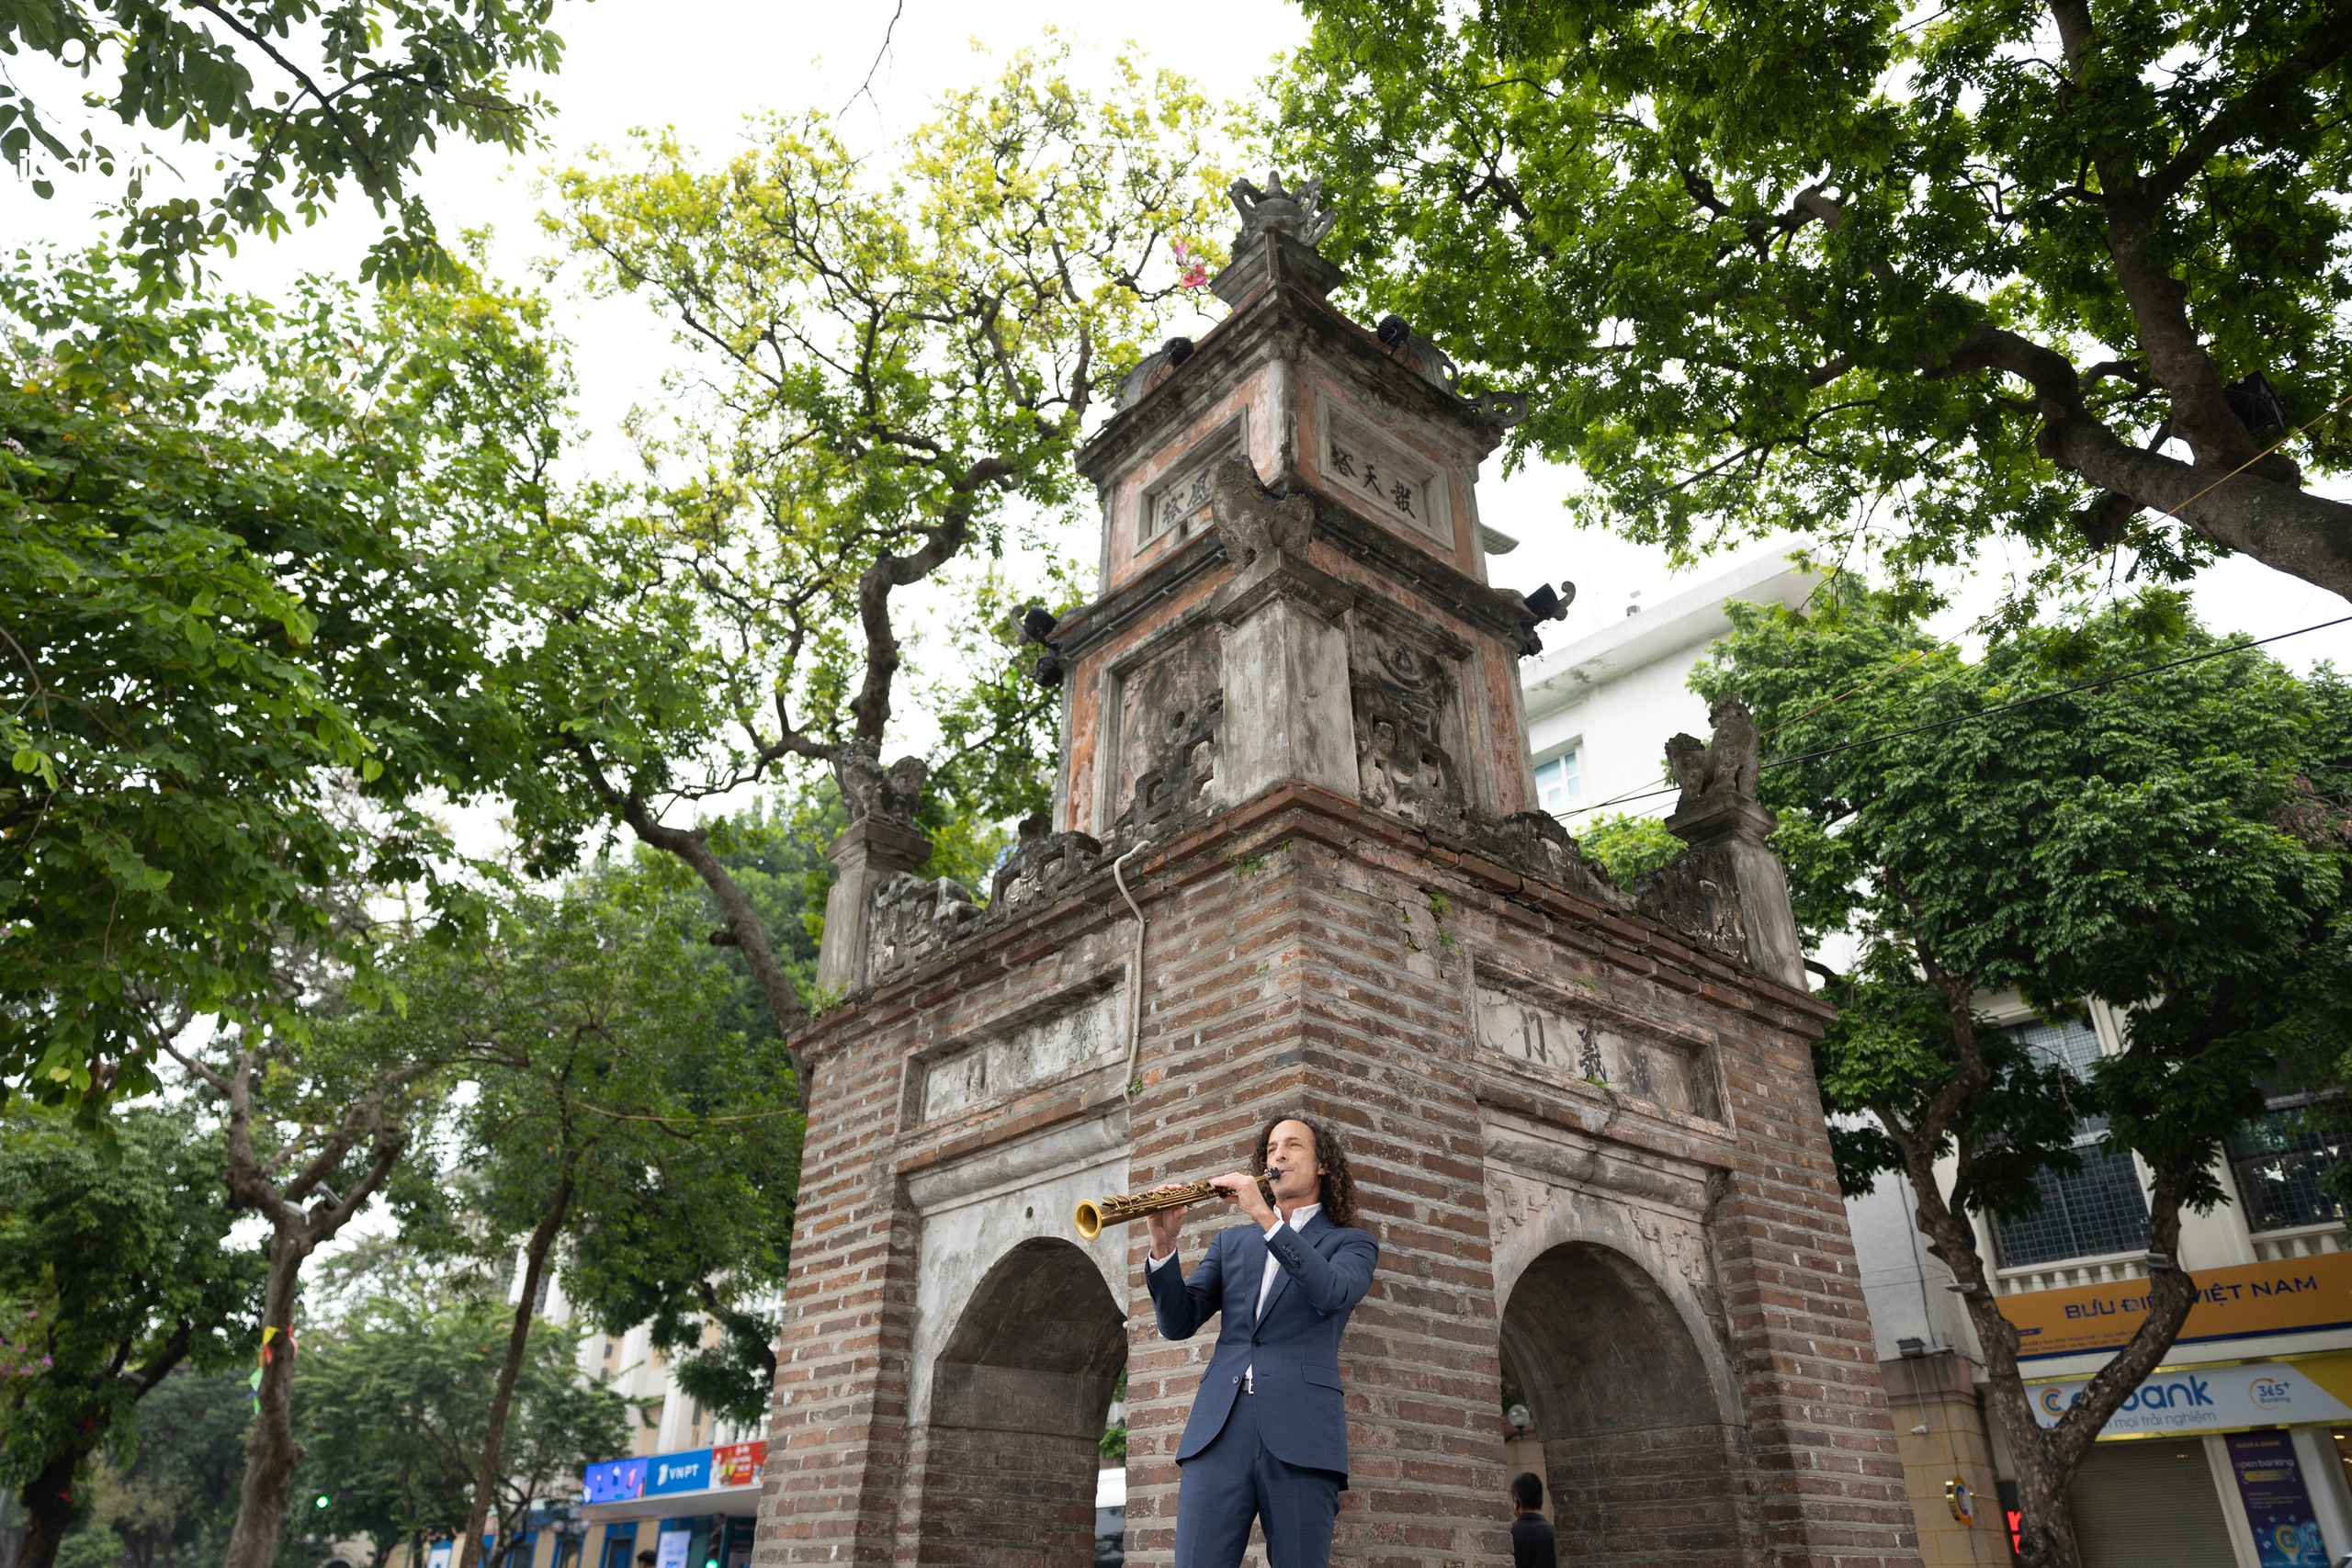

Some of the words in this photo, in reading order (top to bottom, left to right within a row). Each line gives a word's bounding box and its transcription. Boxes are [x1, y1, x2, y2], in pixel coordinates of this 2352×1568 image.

[2064, 1298, 2116, 1319] BƯU
[2120, 1290, 2152, 1313] ĐI
[2250, 1275, 2318, 1297] NAM
[2114, 1417, 2139, 1430] mọi
[2142, 1412, 2163, 1427] trải
[2165, 1411, 2217, 1427] nghiệm
[668, 1463, 700, 1481] VNPT
